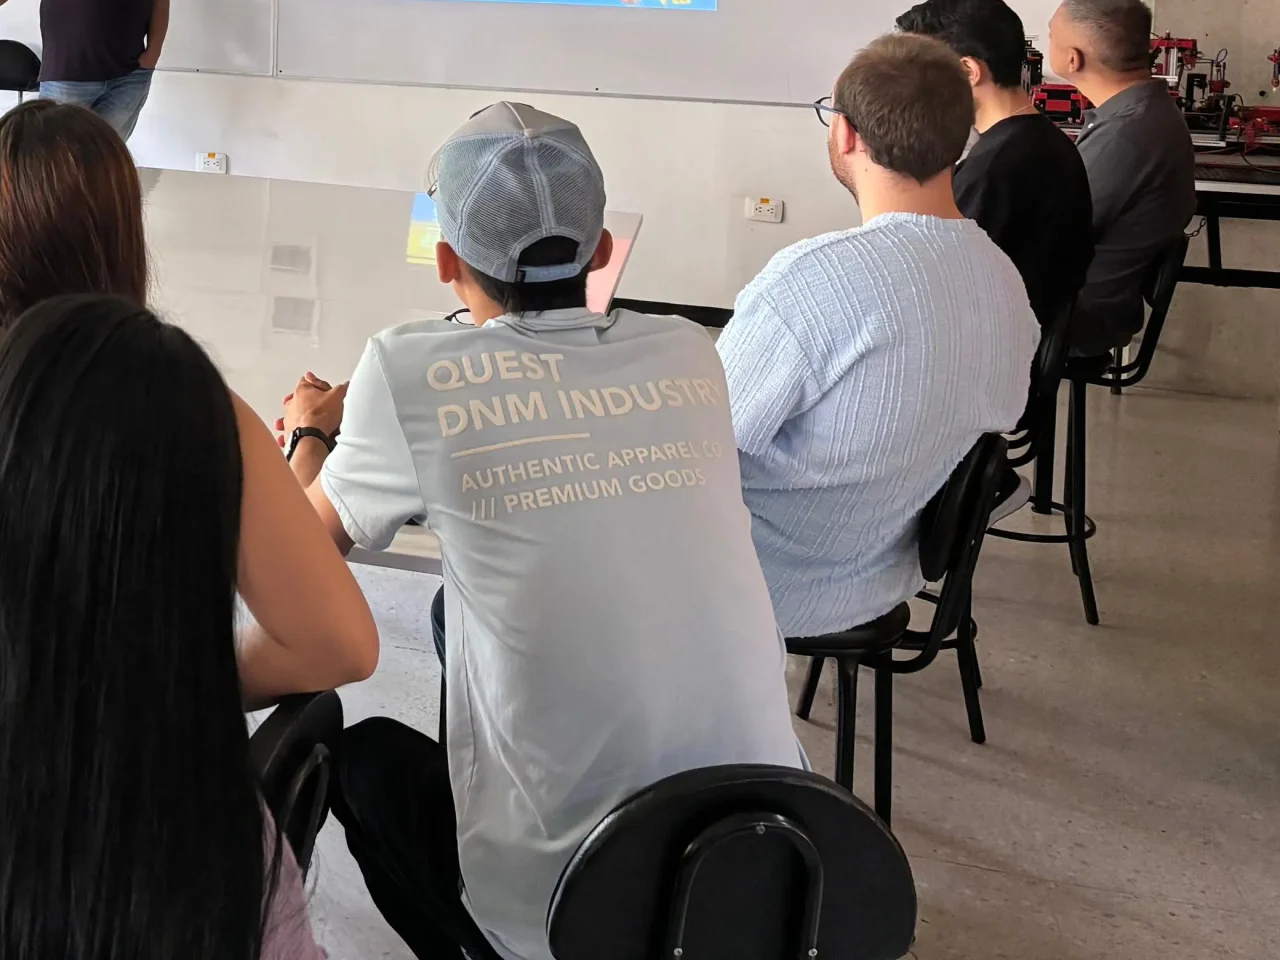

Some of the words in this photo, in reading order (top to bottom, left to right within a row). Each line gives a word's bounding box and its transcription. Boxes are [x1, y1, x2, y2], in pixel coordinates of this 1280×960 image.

[427, 349, 564, 392] QUEST
[437, 389, 549, 438] DNM
[460, 452, 600, 493] AUTHENTIC
[607, 442, 699, 469] APPAREL
[504, 477, 622, 513] PREMIUM
[628, 467, 706, 494] GOODS
